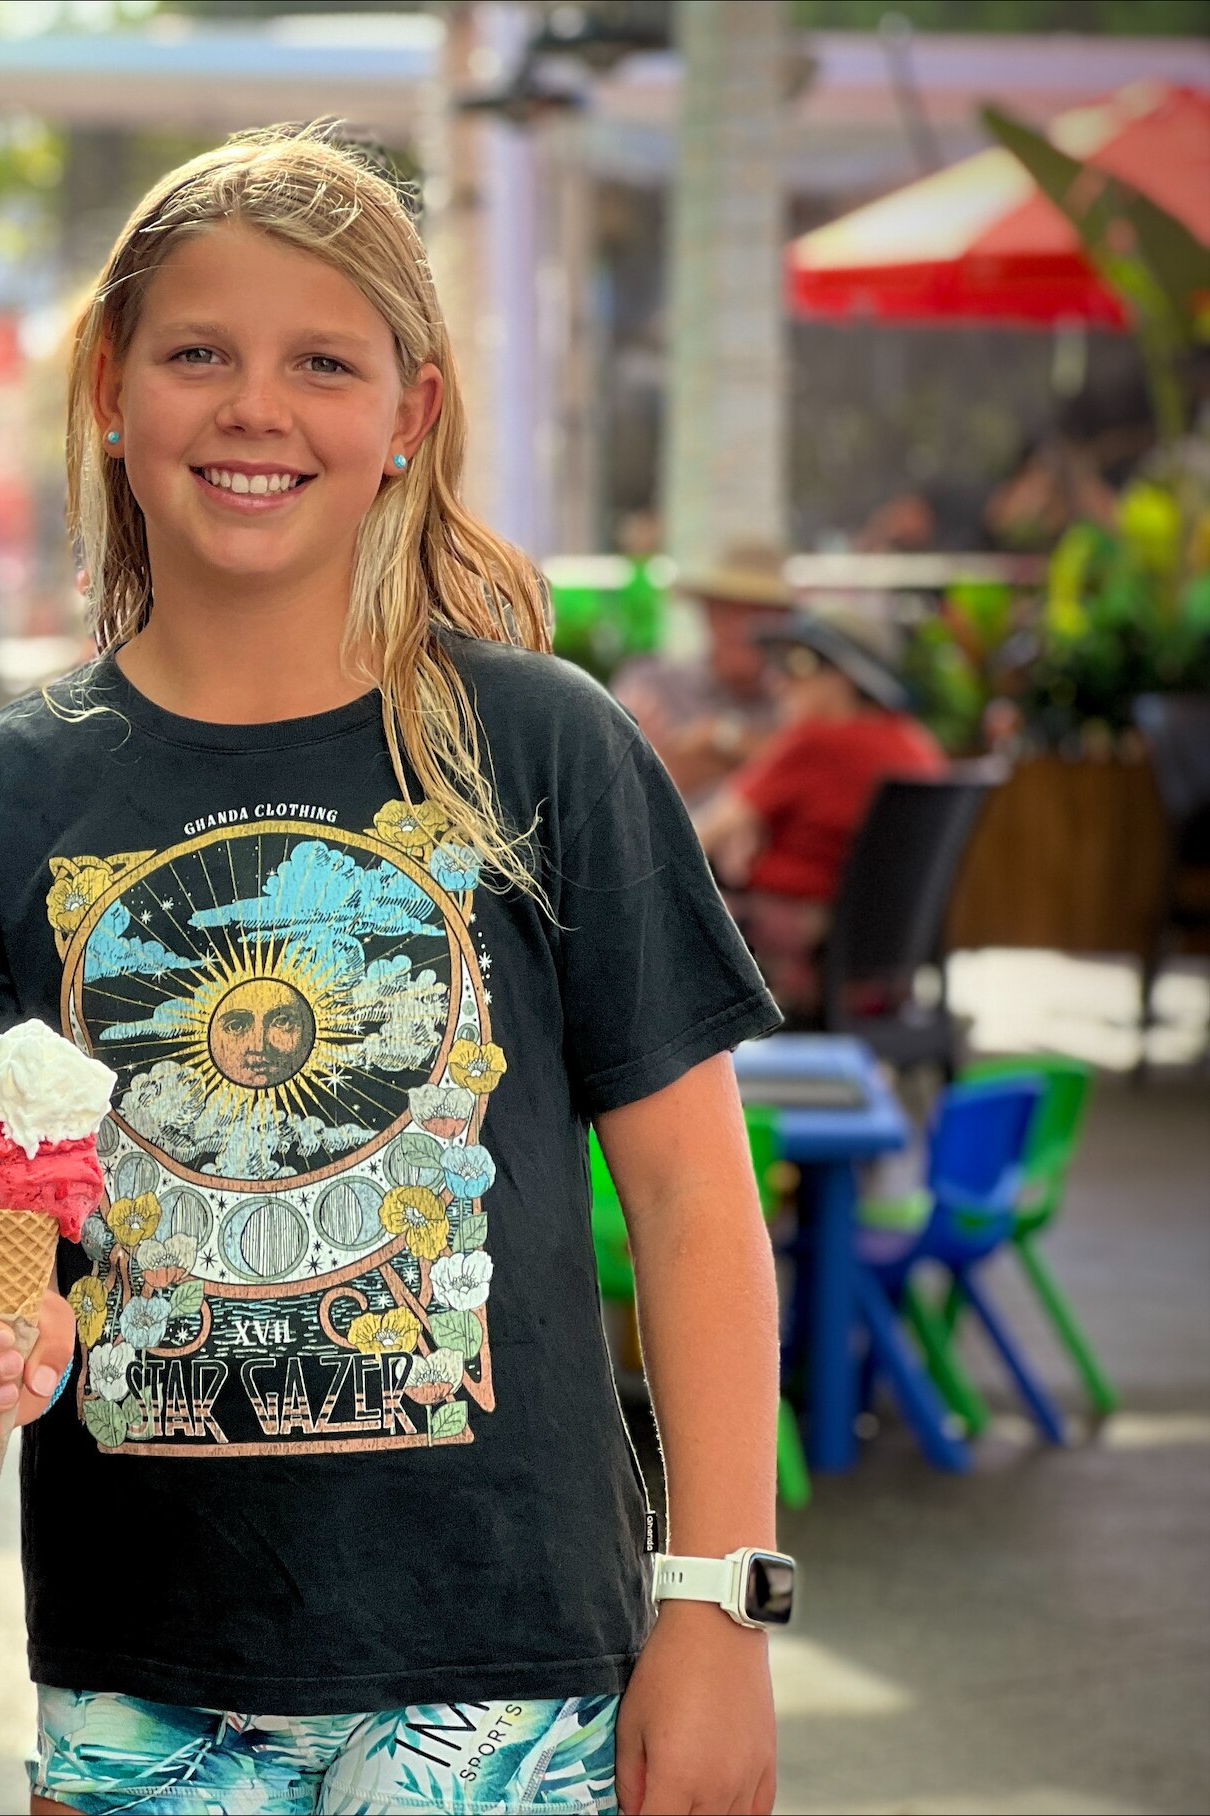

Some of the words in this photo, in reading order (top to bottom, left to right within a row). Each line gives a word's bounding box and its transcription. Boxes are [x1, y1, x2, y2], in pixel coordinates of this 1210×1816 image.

[183, 806, 249, 836] GHANDA
[254, 803, 339, 823] CLOTHING
[125, 1358, 229, 1443] STAR
[241, 1351, 417, 1436] GAZER
[459, 1704, 522, 1782] SPORTS
